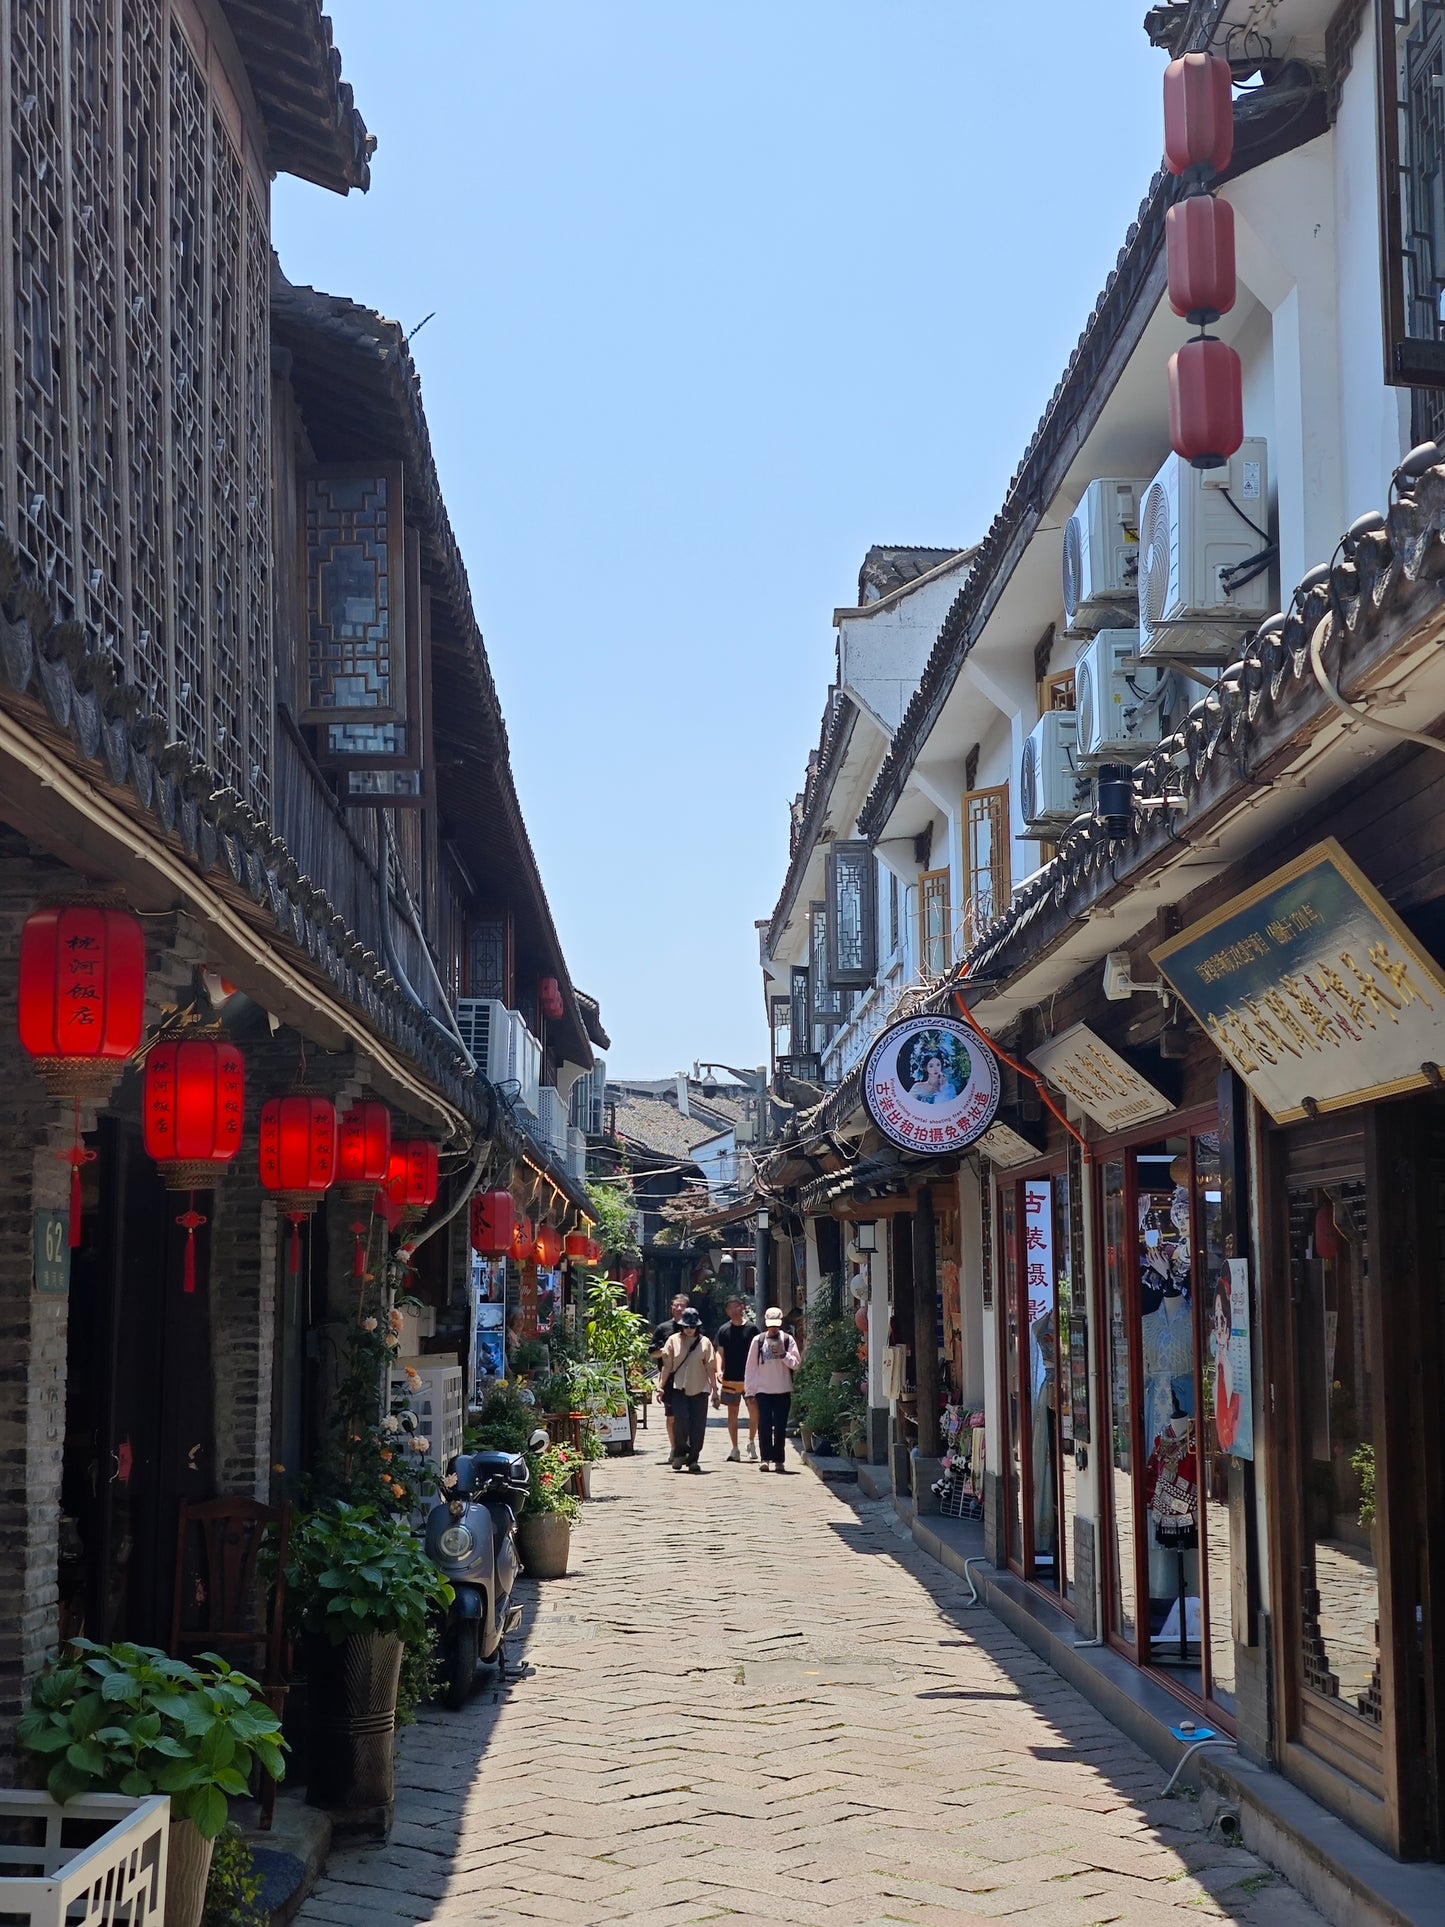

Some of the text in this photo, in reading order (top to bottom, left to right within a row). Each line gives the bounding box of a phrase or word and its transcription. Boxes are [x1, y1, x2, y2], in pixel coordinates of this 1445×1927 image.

[876, 1082, 990, 1143] 古装出租拍摄免费妆造
[896, 1099, 911, 1117] clothing
[912, 1114, 928, 1124] rental
[929, 1117, 952, 1125] shooting
[952, 1110, 963, 1119] free
[46, 1220, 63, 1263] 62
[514, 1222, 528, 1244] 茶
